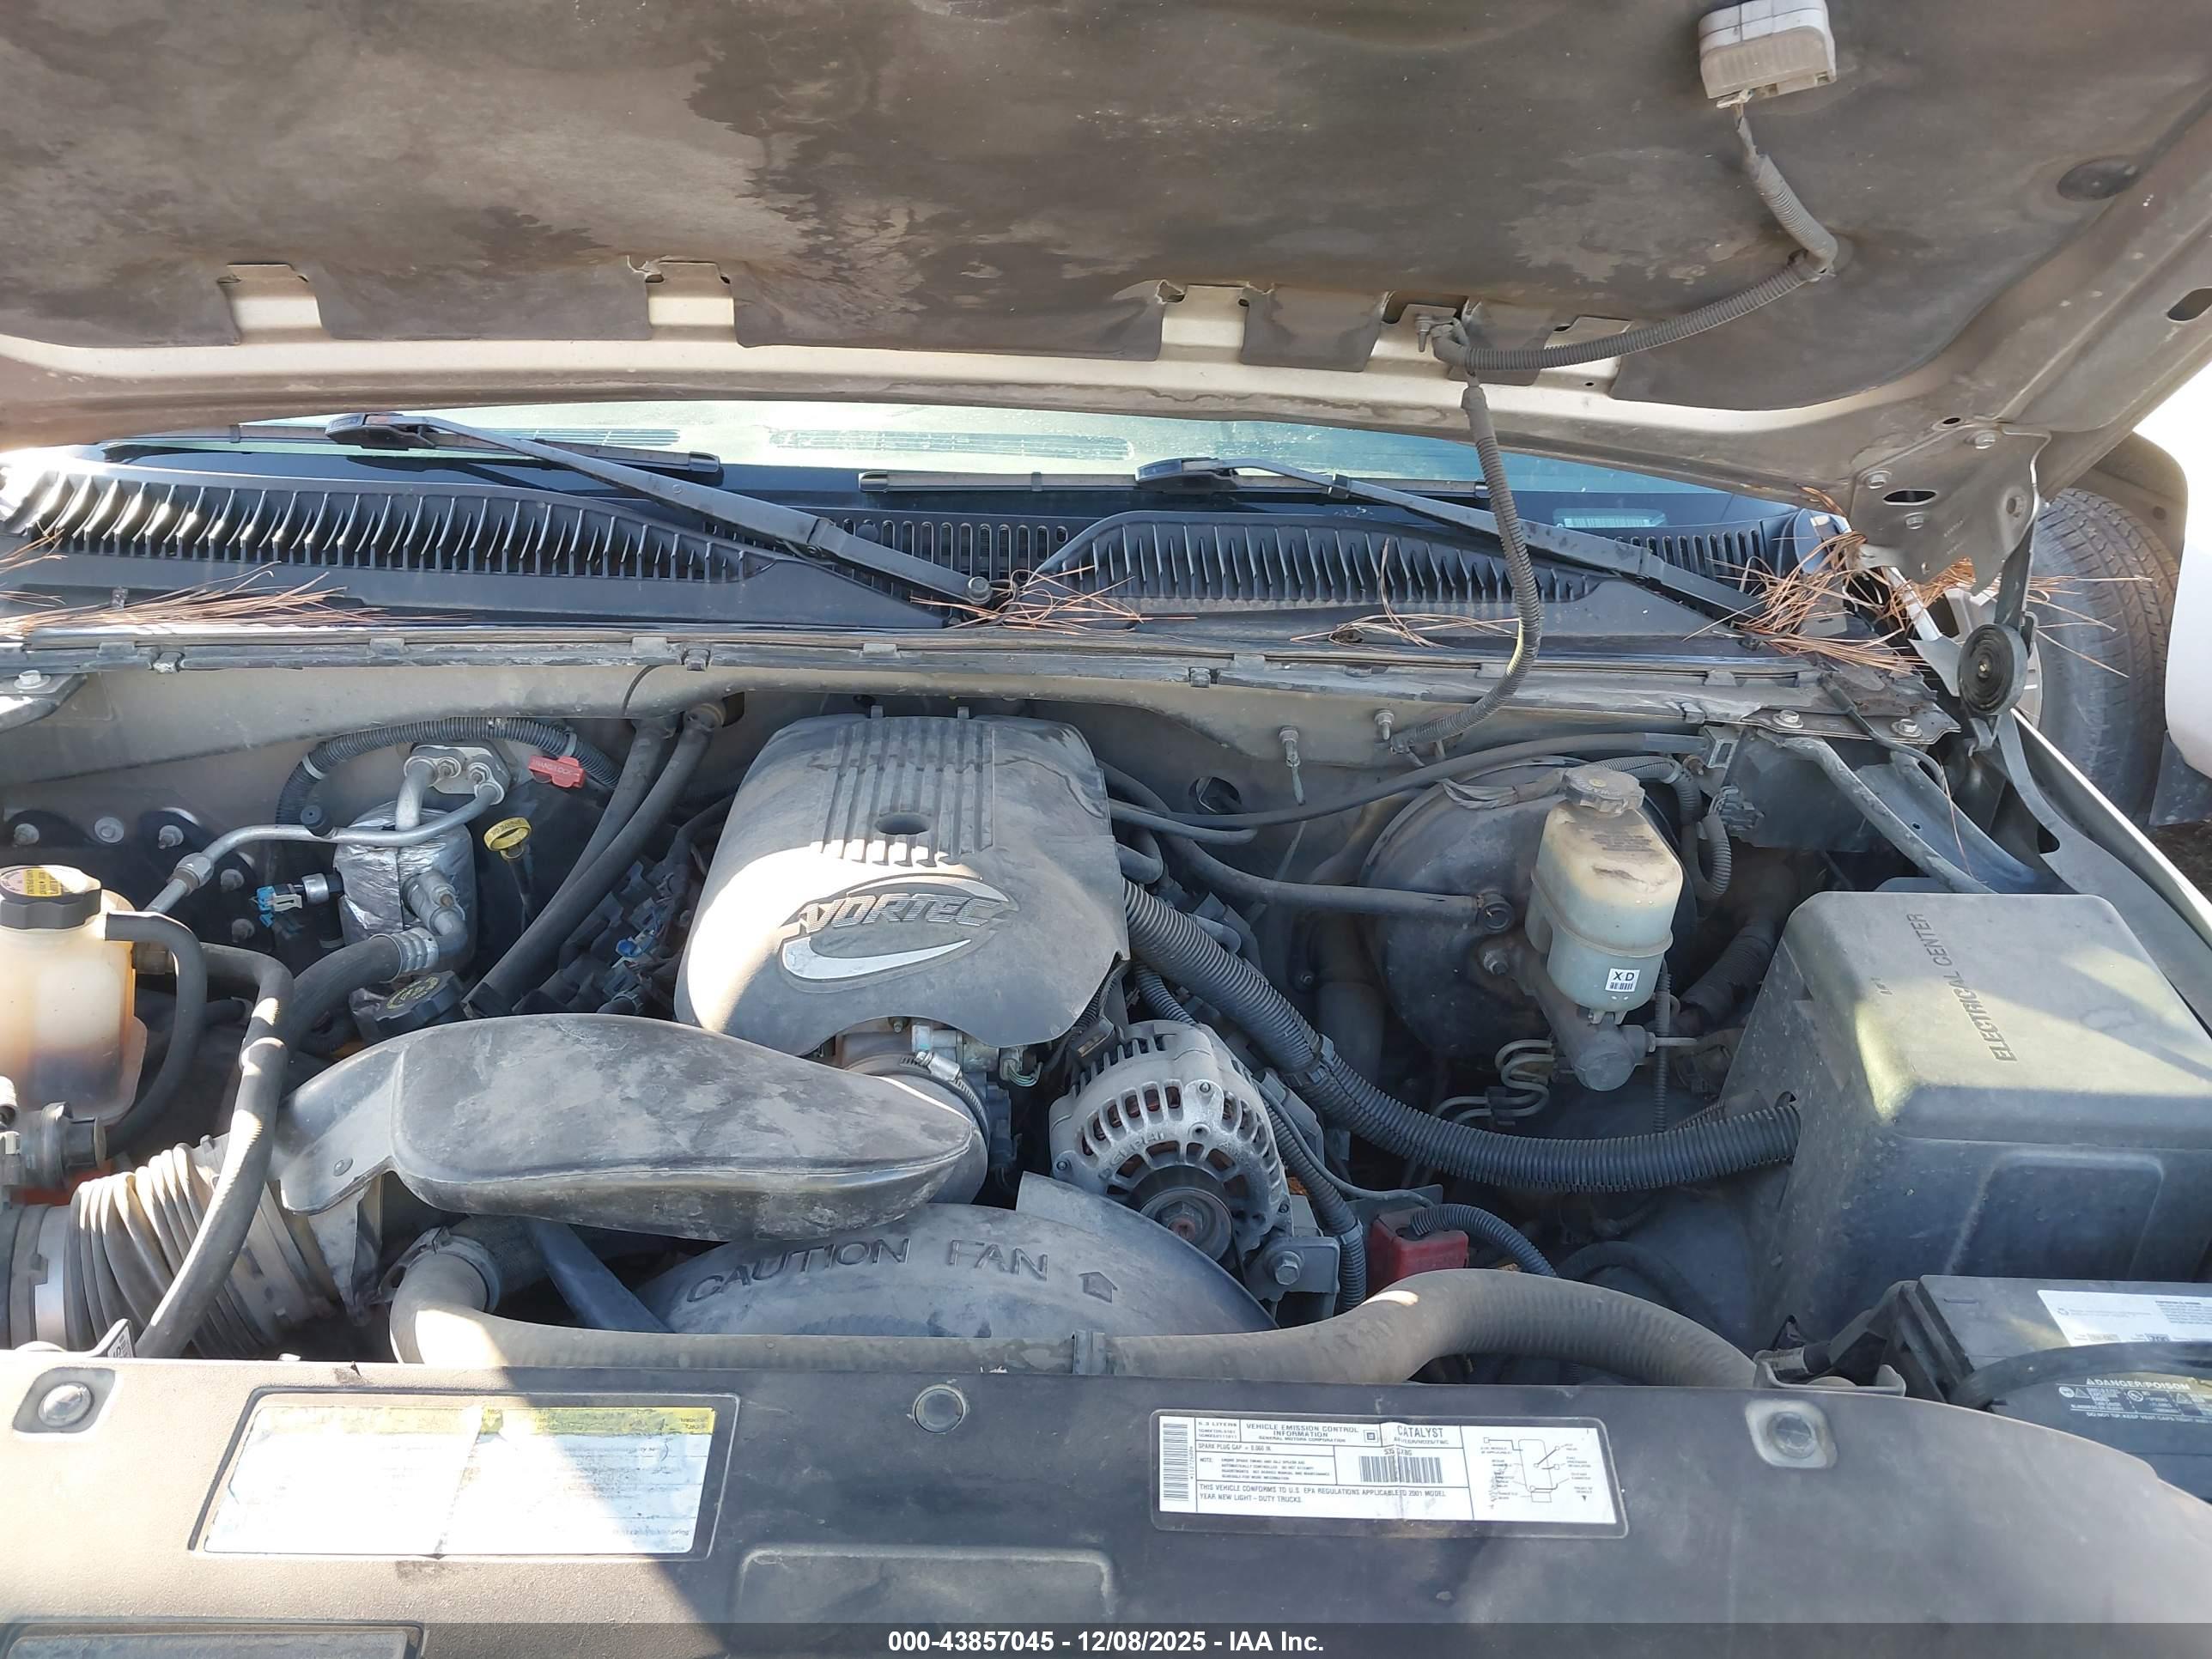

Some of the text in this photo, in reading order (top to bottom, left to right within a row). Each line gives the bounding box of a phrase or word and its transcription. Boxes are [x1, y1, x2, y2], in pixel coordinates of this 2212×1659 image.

[799, 893, 1000, 933] VORTEC
[1906, 914, 2017, 1061] ELECTRICAL CENTER
[687, 1238, 1048, 1302] CAUTION FAN
[1397, 1425, 1443, 1437] CATALYST
